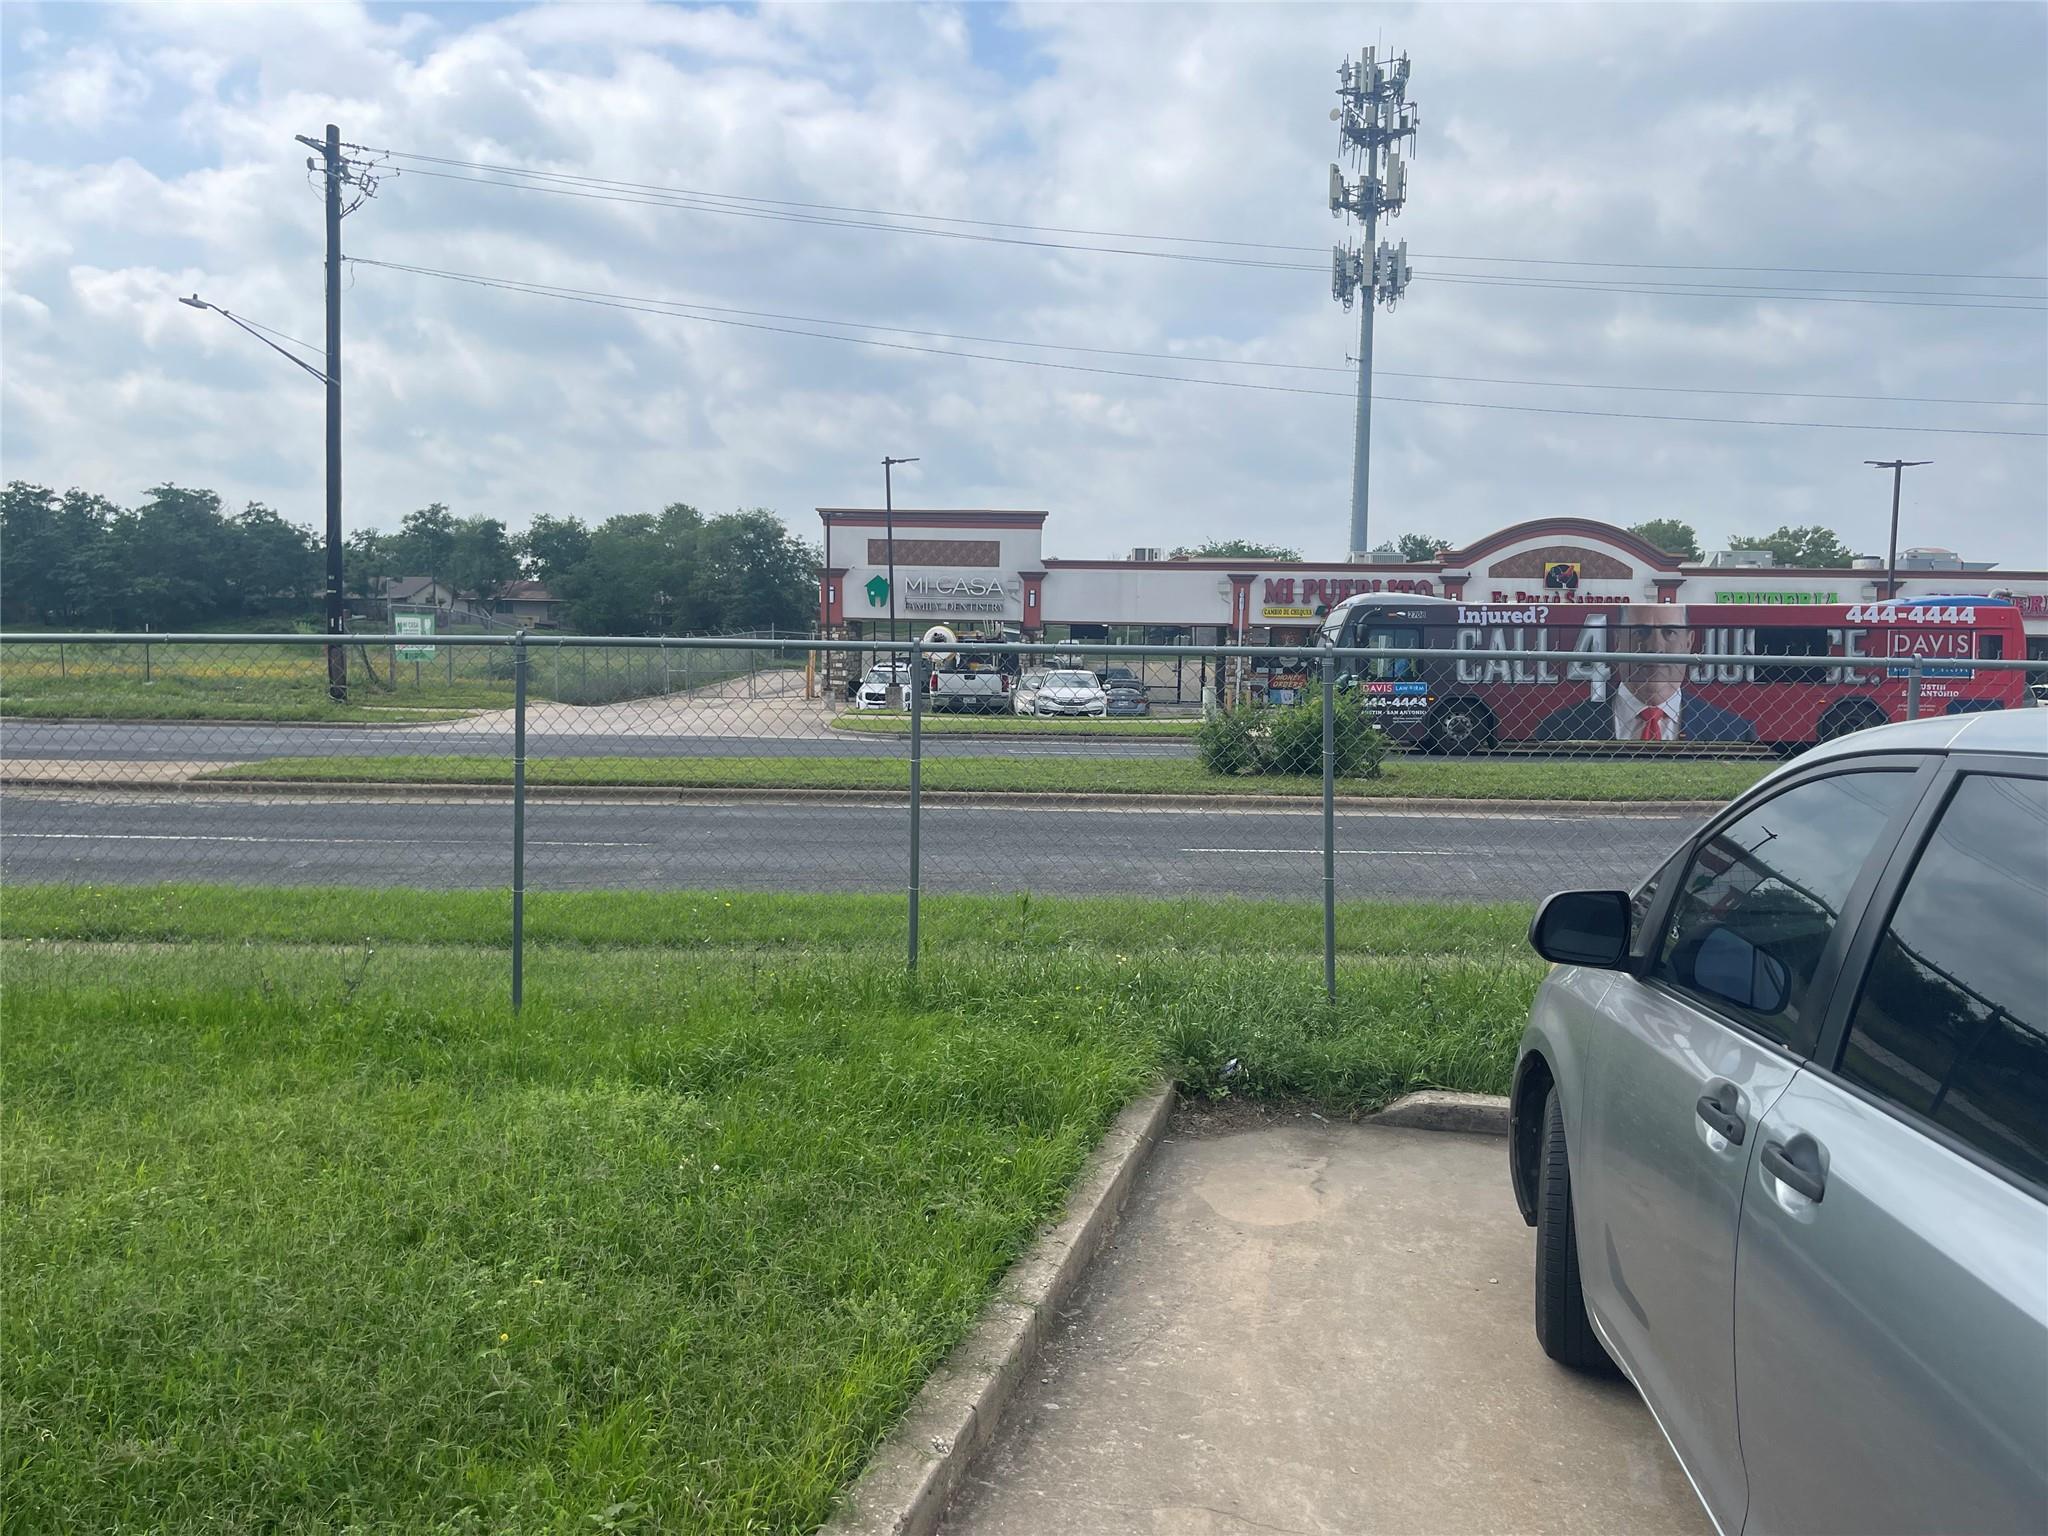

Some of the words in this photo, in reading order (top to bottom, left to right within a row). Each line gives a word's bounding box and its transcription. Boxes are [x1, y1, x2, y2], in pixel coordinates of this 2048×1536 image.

[905, 576, 928, 595] MI
[936, 575, 1004, 596] CASA
[1263, 578, 1295, 604] MI
[905, 602, 941, 612] FAMILY
[946, 602, 1004, 613] DENTISTRY
[1263, 608, 1282, 616] CAMBIO
[1457, 606, 1549, 626] Injured?
[1845, 605, 1976, 624] 444-4444
[1894, 634, 1969, 653] DAVIS
[1456, 628, 1559, 684] CALL
[1567, 613, 1611, 703] 4
[1362, 684, 1393, 693] DAVIS
